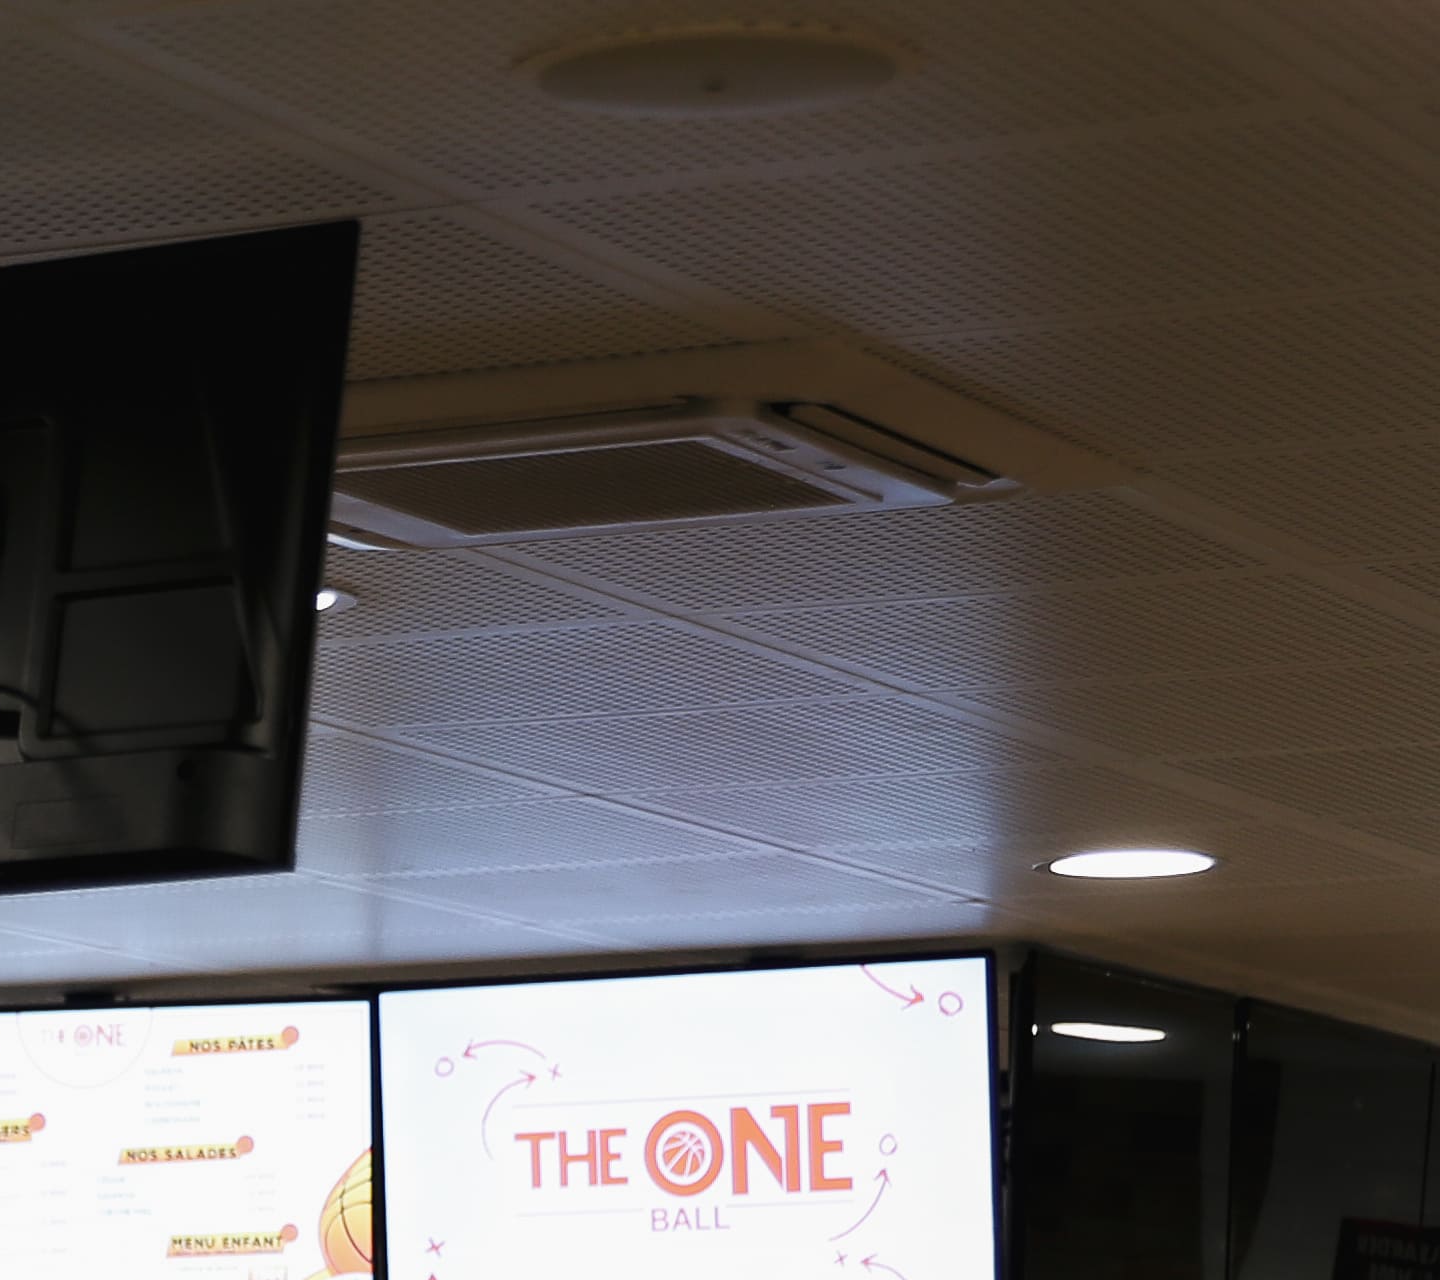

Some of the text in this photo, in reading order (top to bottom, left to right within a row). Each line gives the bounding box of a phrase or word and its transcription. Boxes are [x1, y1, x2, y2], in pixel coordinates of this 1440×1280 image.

[189, 1037, 275, 1053] NOS PÂTES
[126, 1147, 237, 1162] NOS SALADES
[514, 1102, 854, 1197] THE ONE
[651, 1206, 731, 1233] BALL
[171, 1235, 284, 1250] MENU ENFANT
